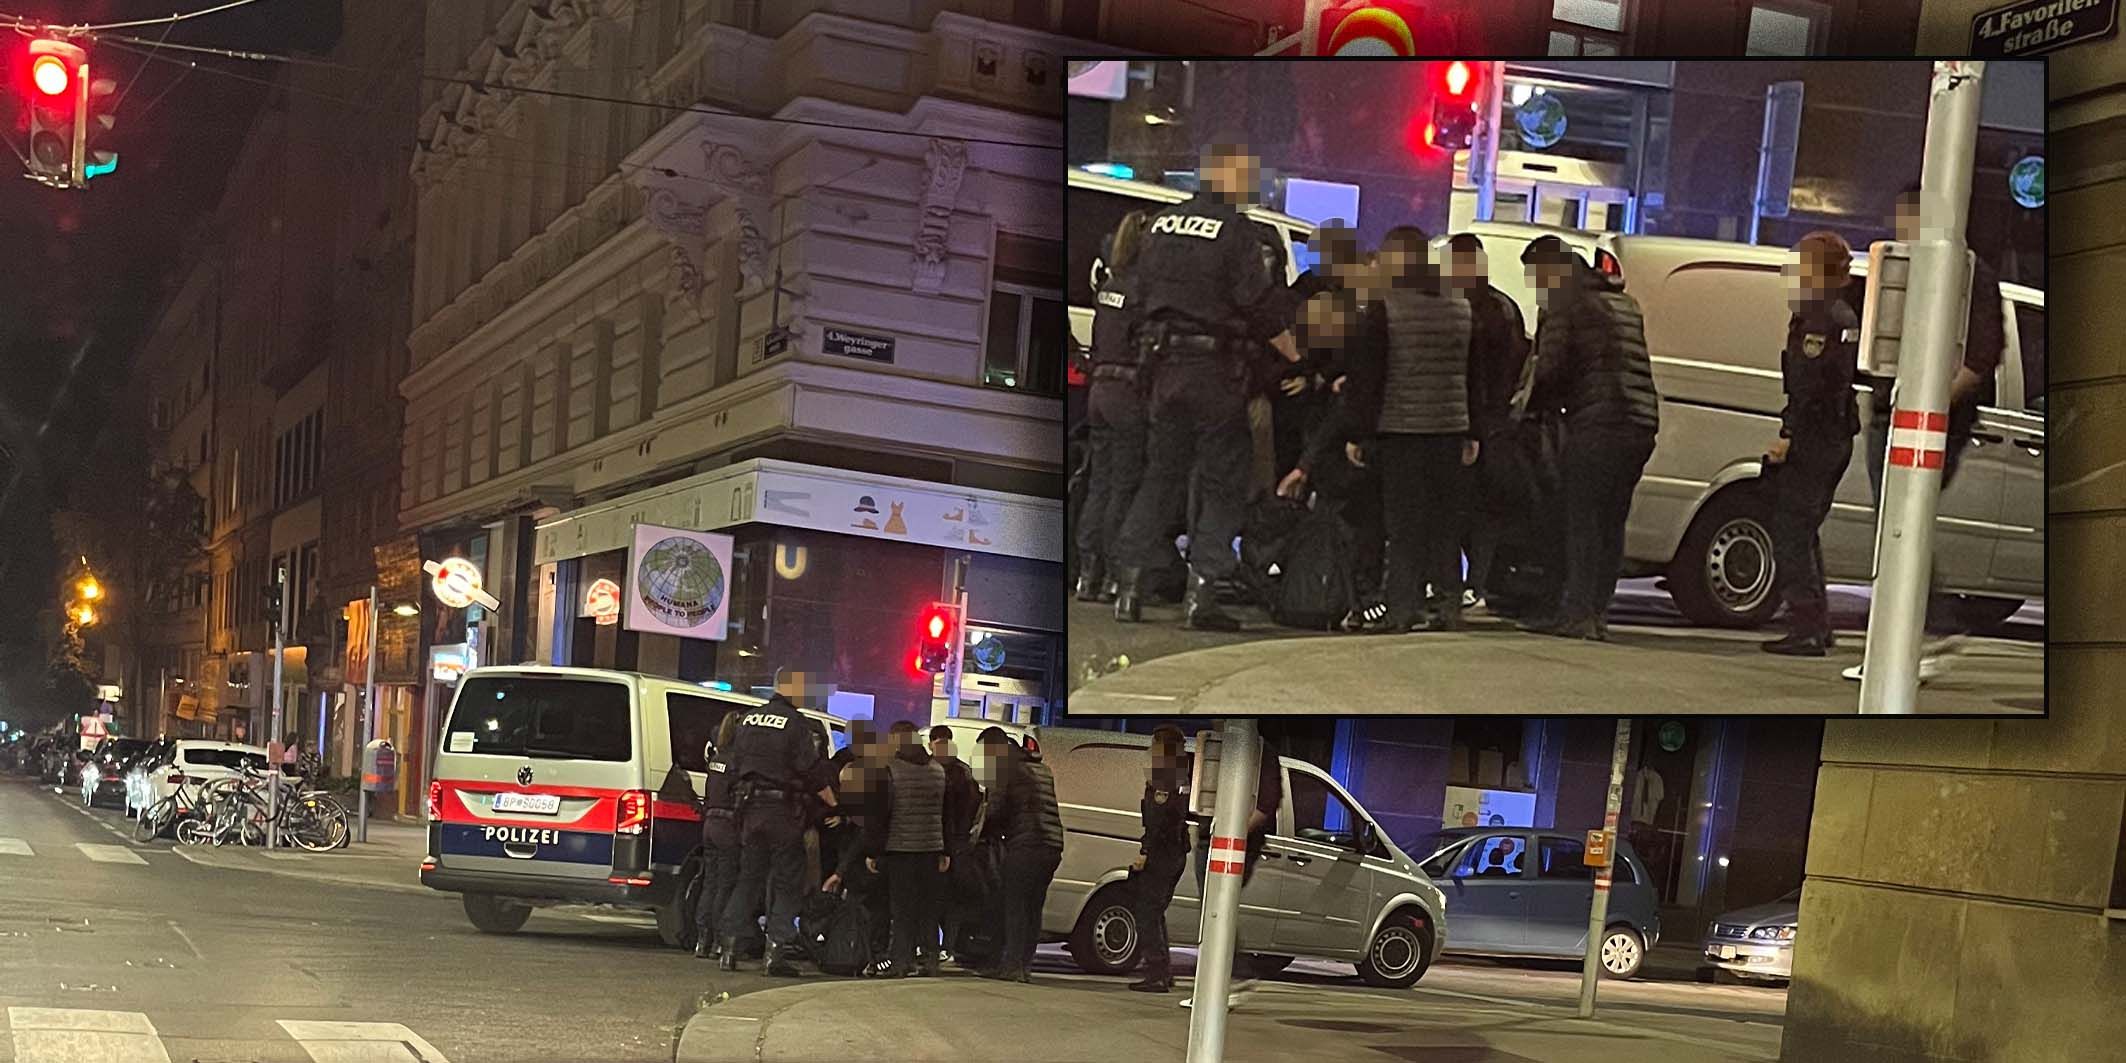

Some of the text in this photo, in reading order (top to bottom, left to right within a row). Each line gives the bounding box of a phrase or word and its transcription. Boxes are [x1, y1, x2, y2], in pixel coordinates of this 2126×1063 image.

[2004, 18, 2074, 53] straße
[1151, 214, 1223, 239] POLIZEI
[660, 595, 699, 608] HUMANA
[743, 714, 788, 729] POLIZEI
[486, 826, 559, 845] POLIZEI
